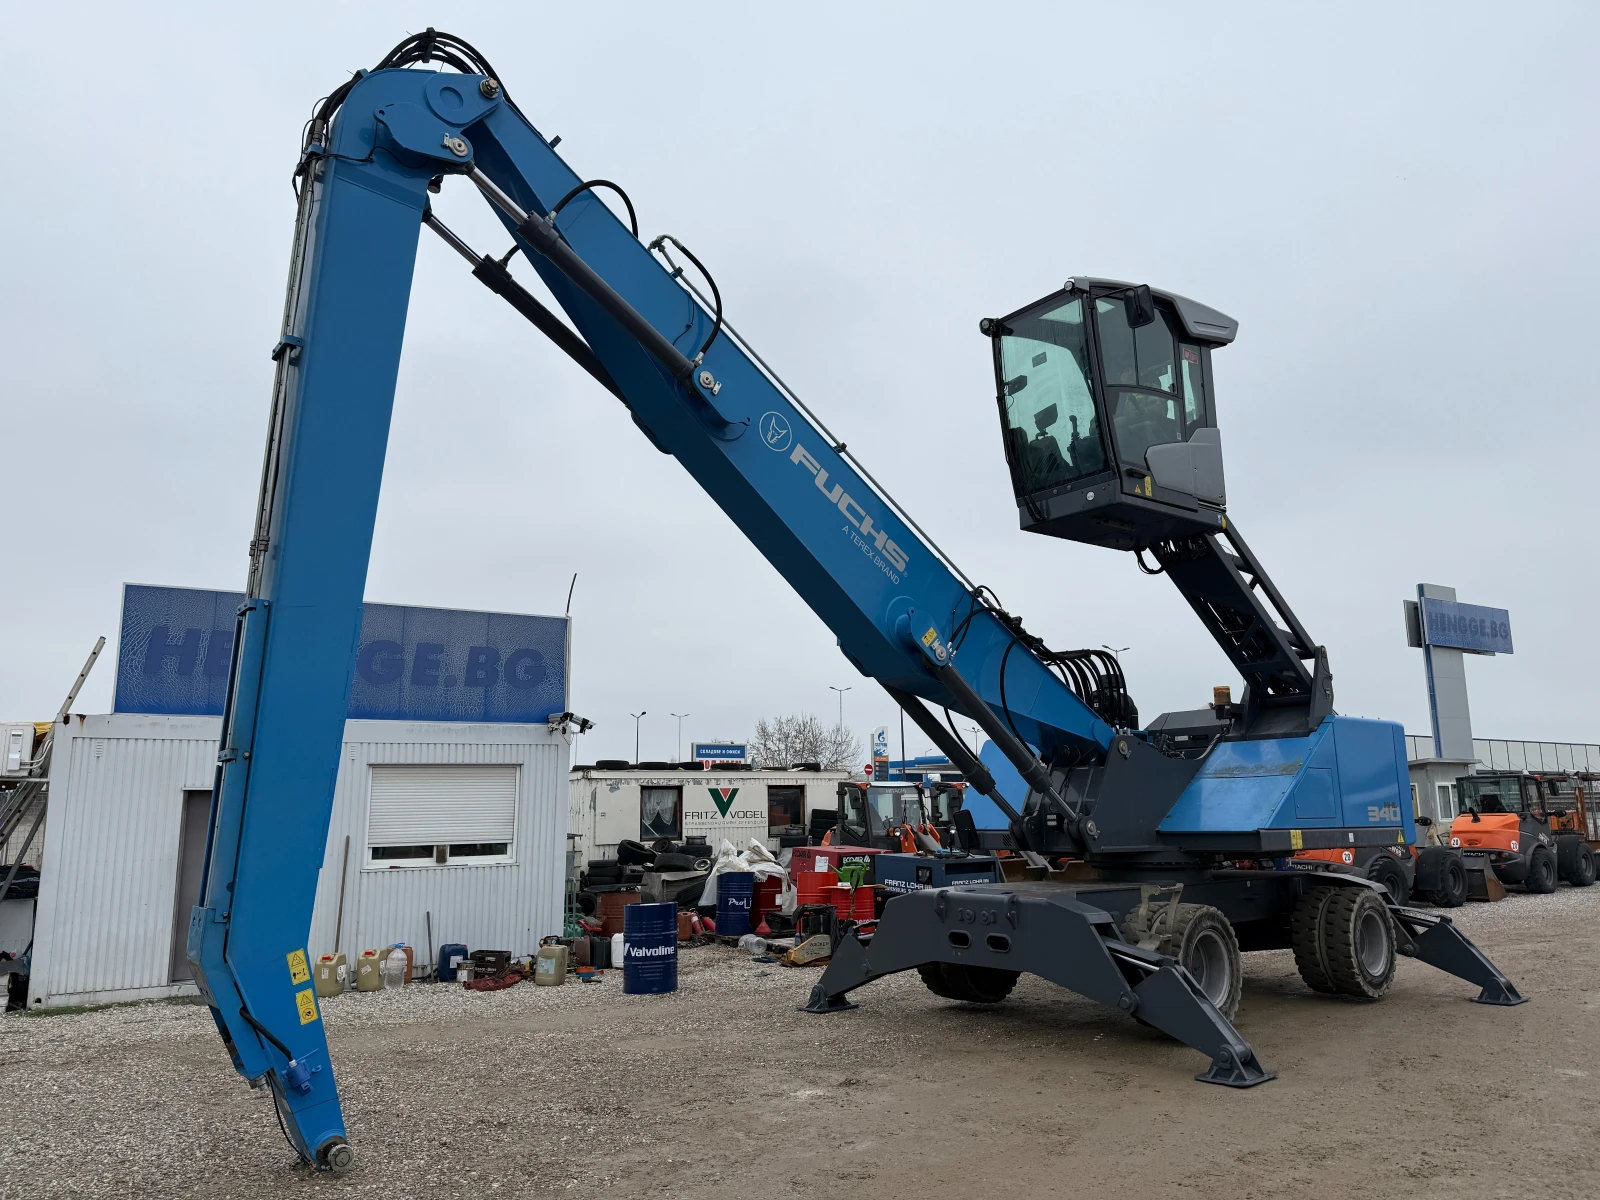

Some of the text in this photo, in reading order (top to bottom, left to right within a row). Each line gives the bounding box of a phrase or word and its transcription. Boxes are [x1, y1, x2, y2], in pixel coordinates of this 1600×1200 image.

[790, 443, 909, 573] FUCHS
[842, 525, 900, 585] A TEREX BRAND
[143, 626, 547, 690] HEGE.BG
[684, 810, 767, 820] FRITZ VOGEL
[1368, 806, 1401, 822] 340
[884, 879, 906, 888] FRANZ
[629, 945, 675, 957] Valvoline
